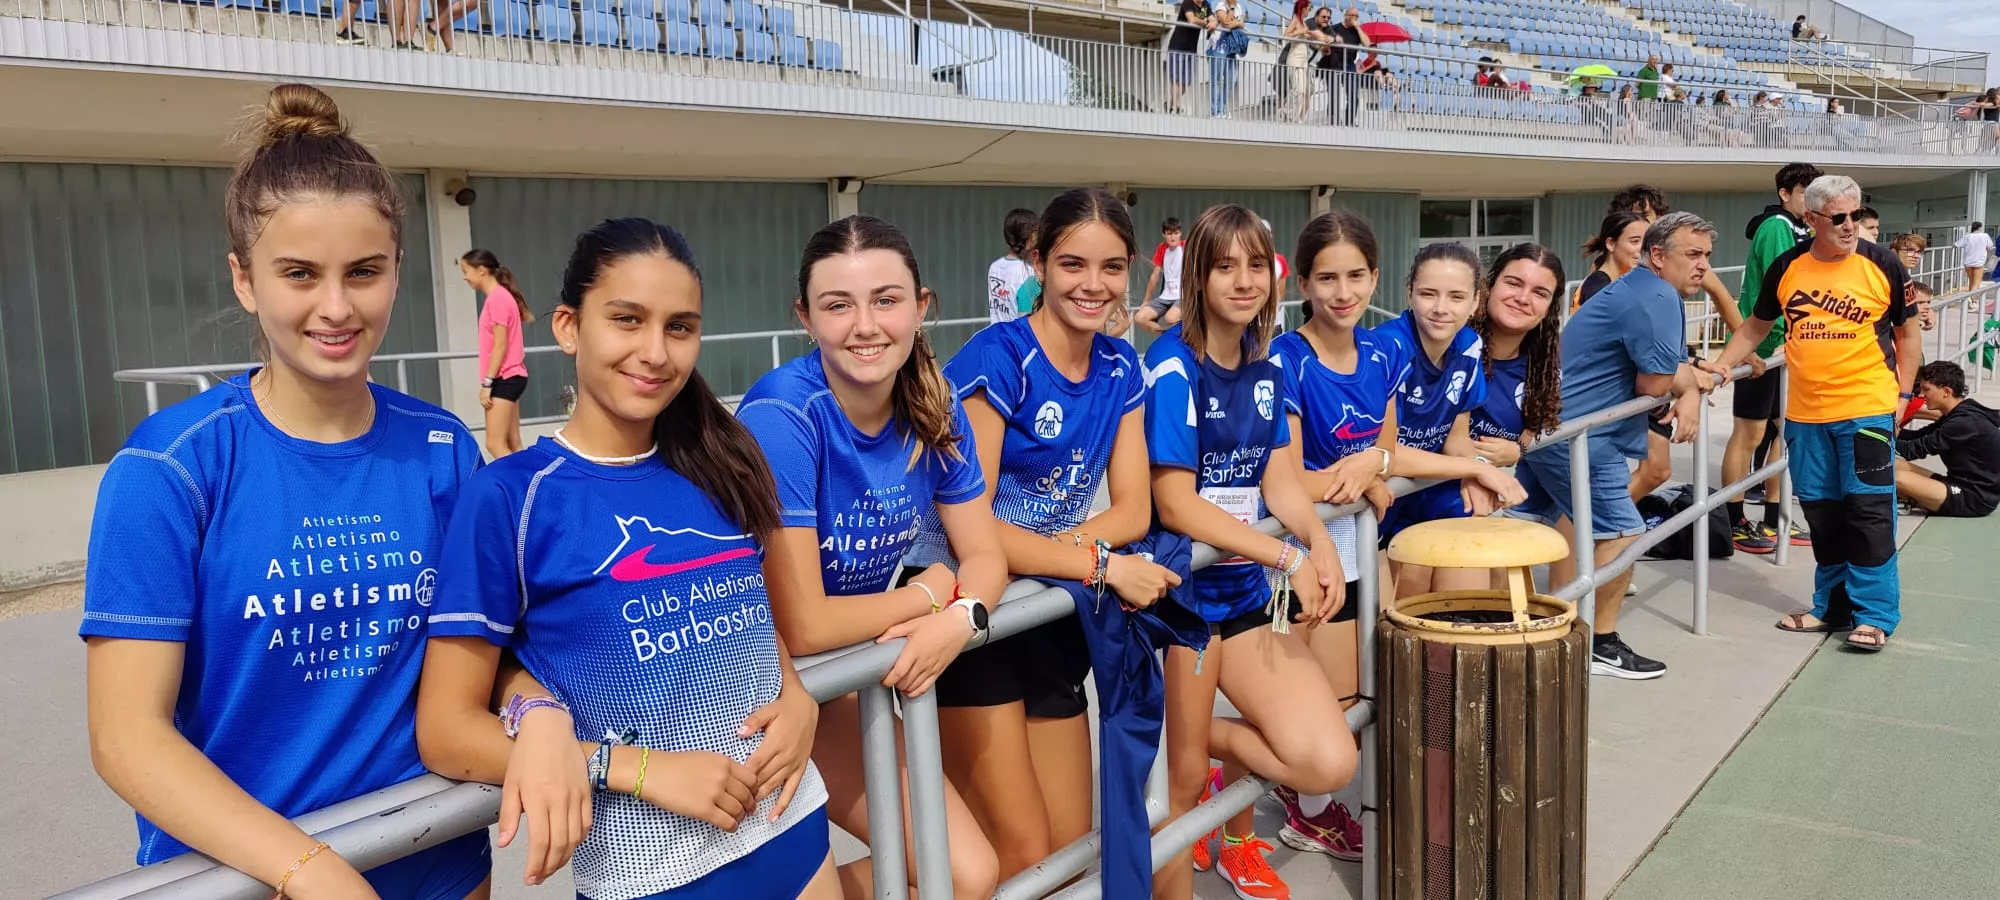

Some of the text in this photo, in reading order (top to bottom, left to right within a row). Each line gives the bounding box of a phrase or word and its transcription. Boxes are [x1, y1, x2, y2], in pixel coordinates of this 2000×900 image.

[1799, 331, 1857, 340] atletismo
[1800, 321, 1826, 330] club
[303, 513, 382, 528] Atletismo
[834, 505, 917, 528] Atletismo
[292, 530, 400, 550] Atletismo
[266, 550, 423, 580] Atletismo
[622, 573, 764, 623] Club Atletismo
[268, 615, 421, 650] Atletismo
[630, 603, 768, 663] Barbastro
[292, 641, 400, 667] Atletismo
